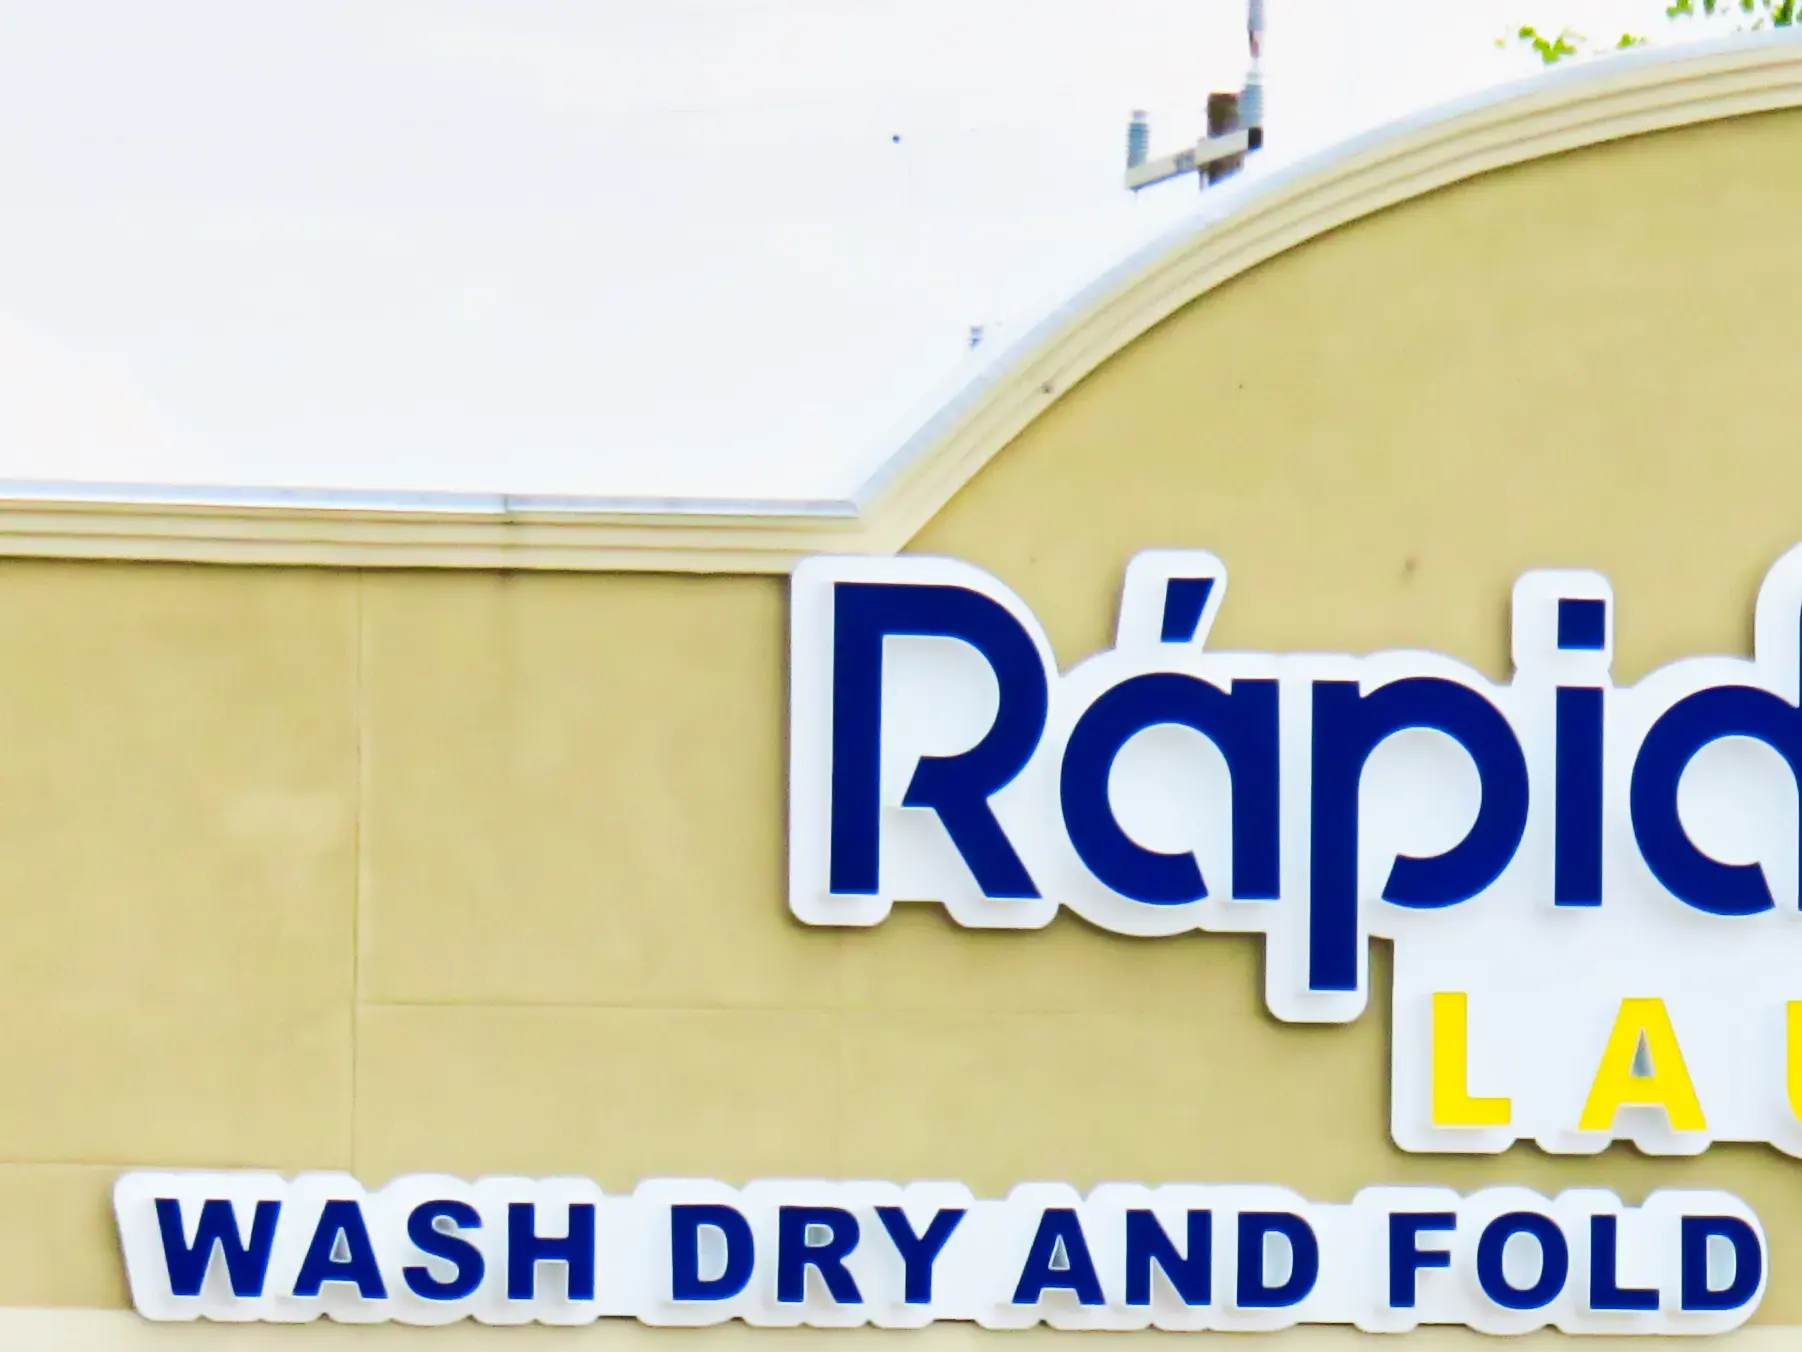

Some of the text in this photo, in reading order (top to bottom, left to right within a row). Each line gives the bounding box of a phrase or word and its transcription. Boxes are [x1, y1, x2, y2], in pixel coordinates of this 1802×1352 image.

[154, 1198, 1763, 1312] WASH DRY AND FOLD
